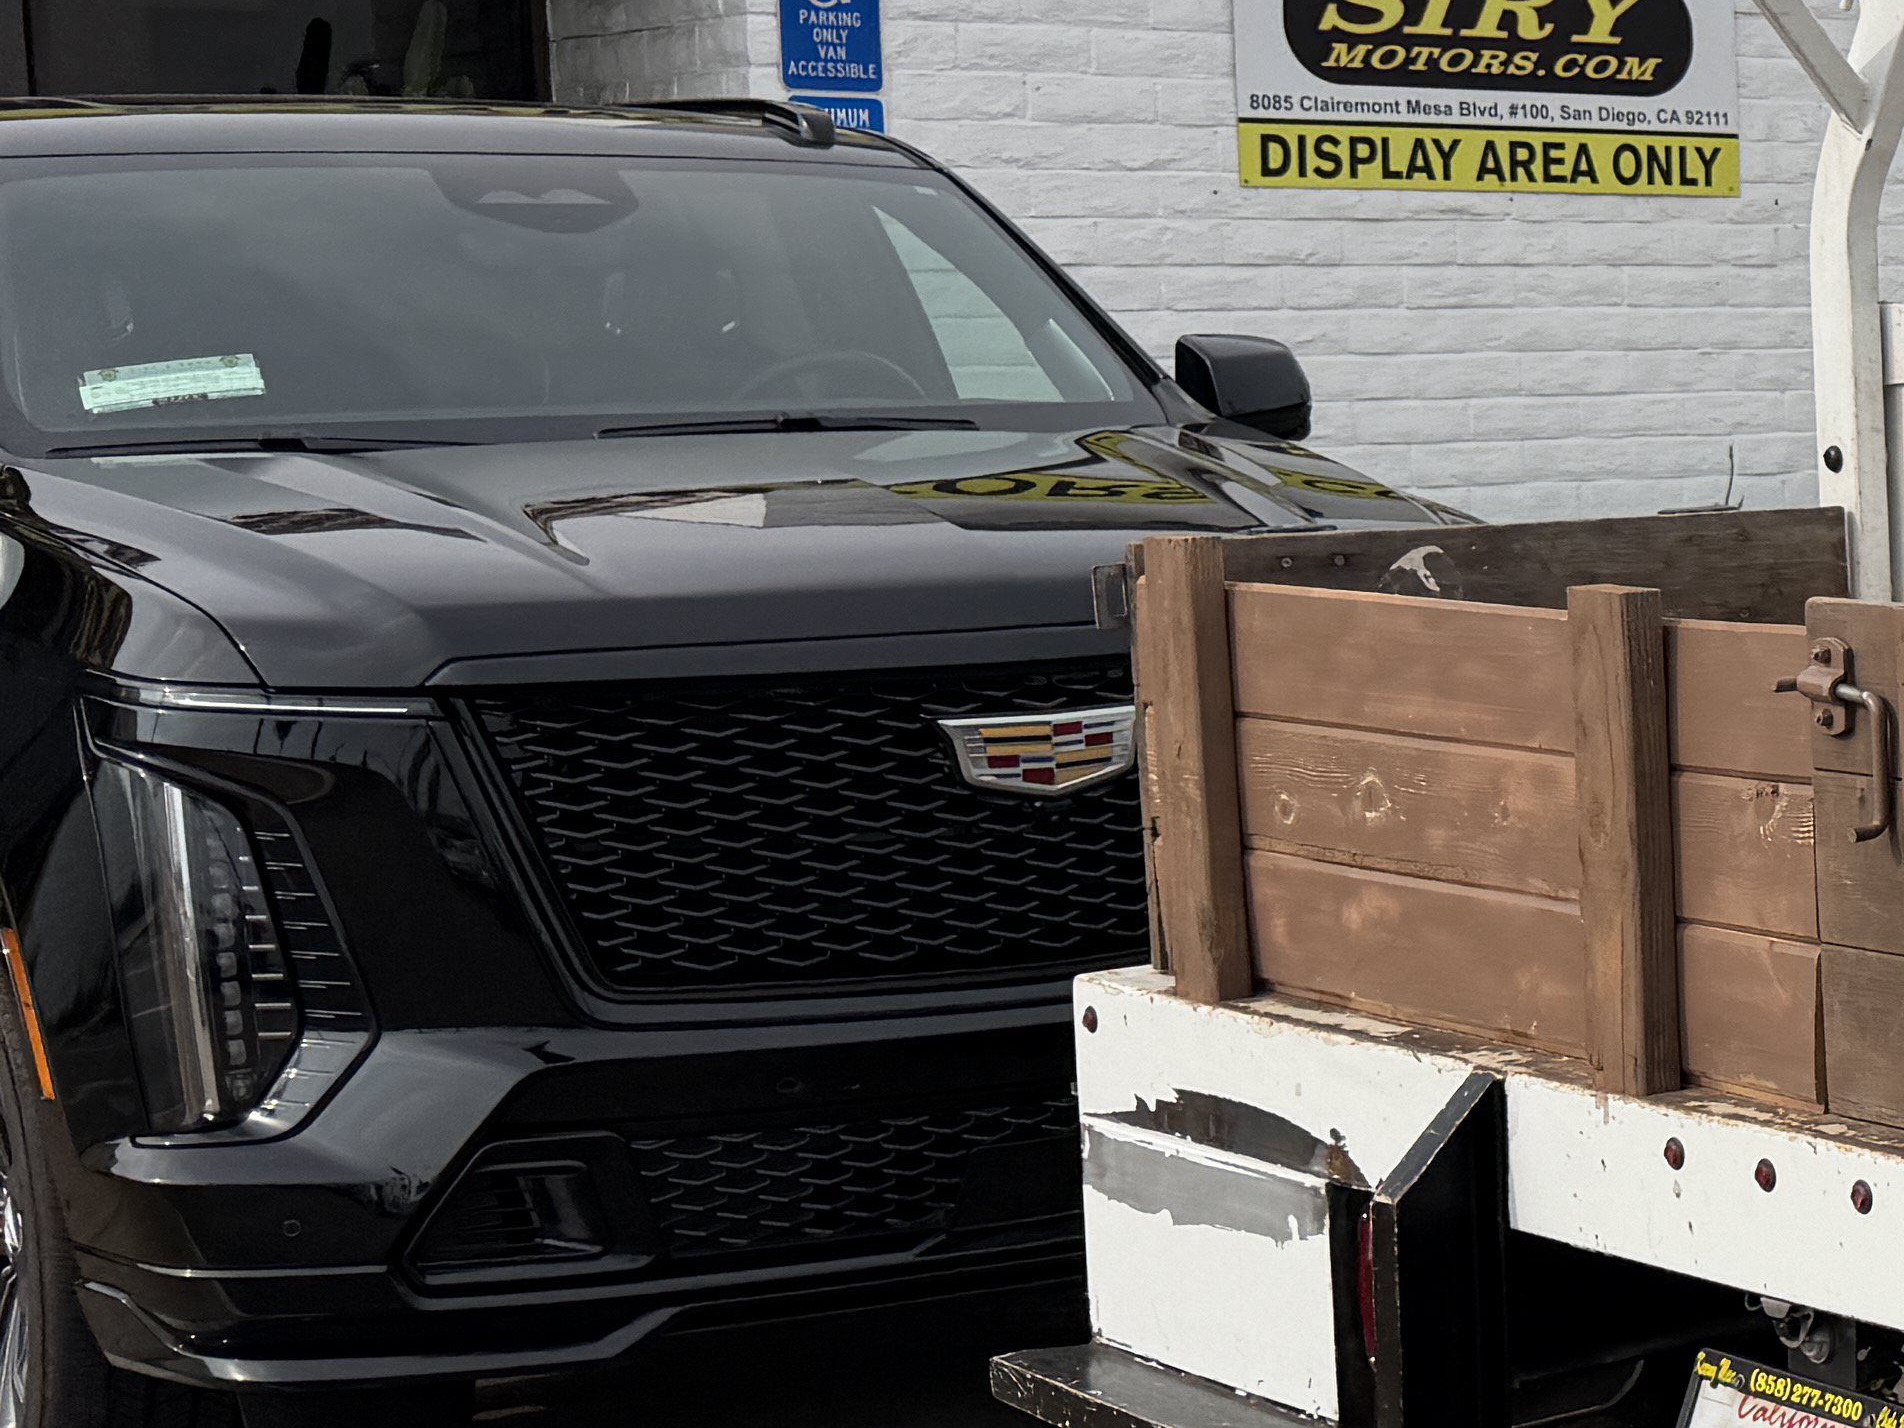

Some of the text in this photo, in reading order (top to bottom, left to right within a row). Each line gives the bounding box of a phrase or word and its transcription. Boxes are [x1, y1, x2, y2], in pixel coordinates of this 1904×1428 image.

[799, 9, 862, 28] PARKING
[812, 27, 849, 44] ONLY
[818, 44, 847, 61] VAN
[1321, 42, 1663, 82] MOTORS.COM
[788, 61, 878, 79] ACCESSIBLE
[824, 108, 870, 128] IMUM
[1249, 93, 1731, 128] 8085 Clairemont Mesa Blvd, #100, San Diego, CA 92111
[1259, 132, 1722, 188] DISPLAY AREA ONLY
